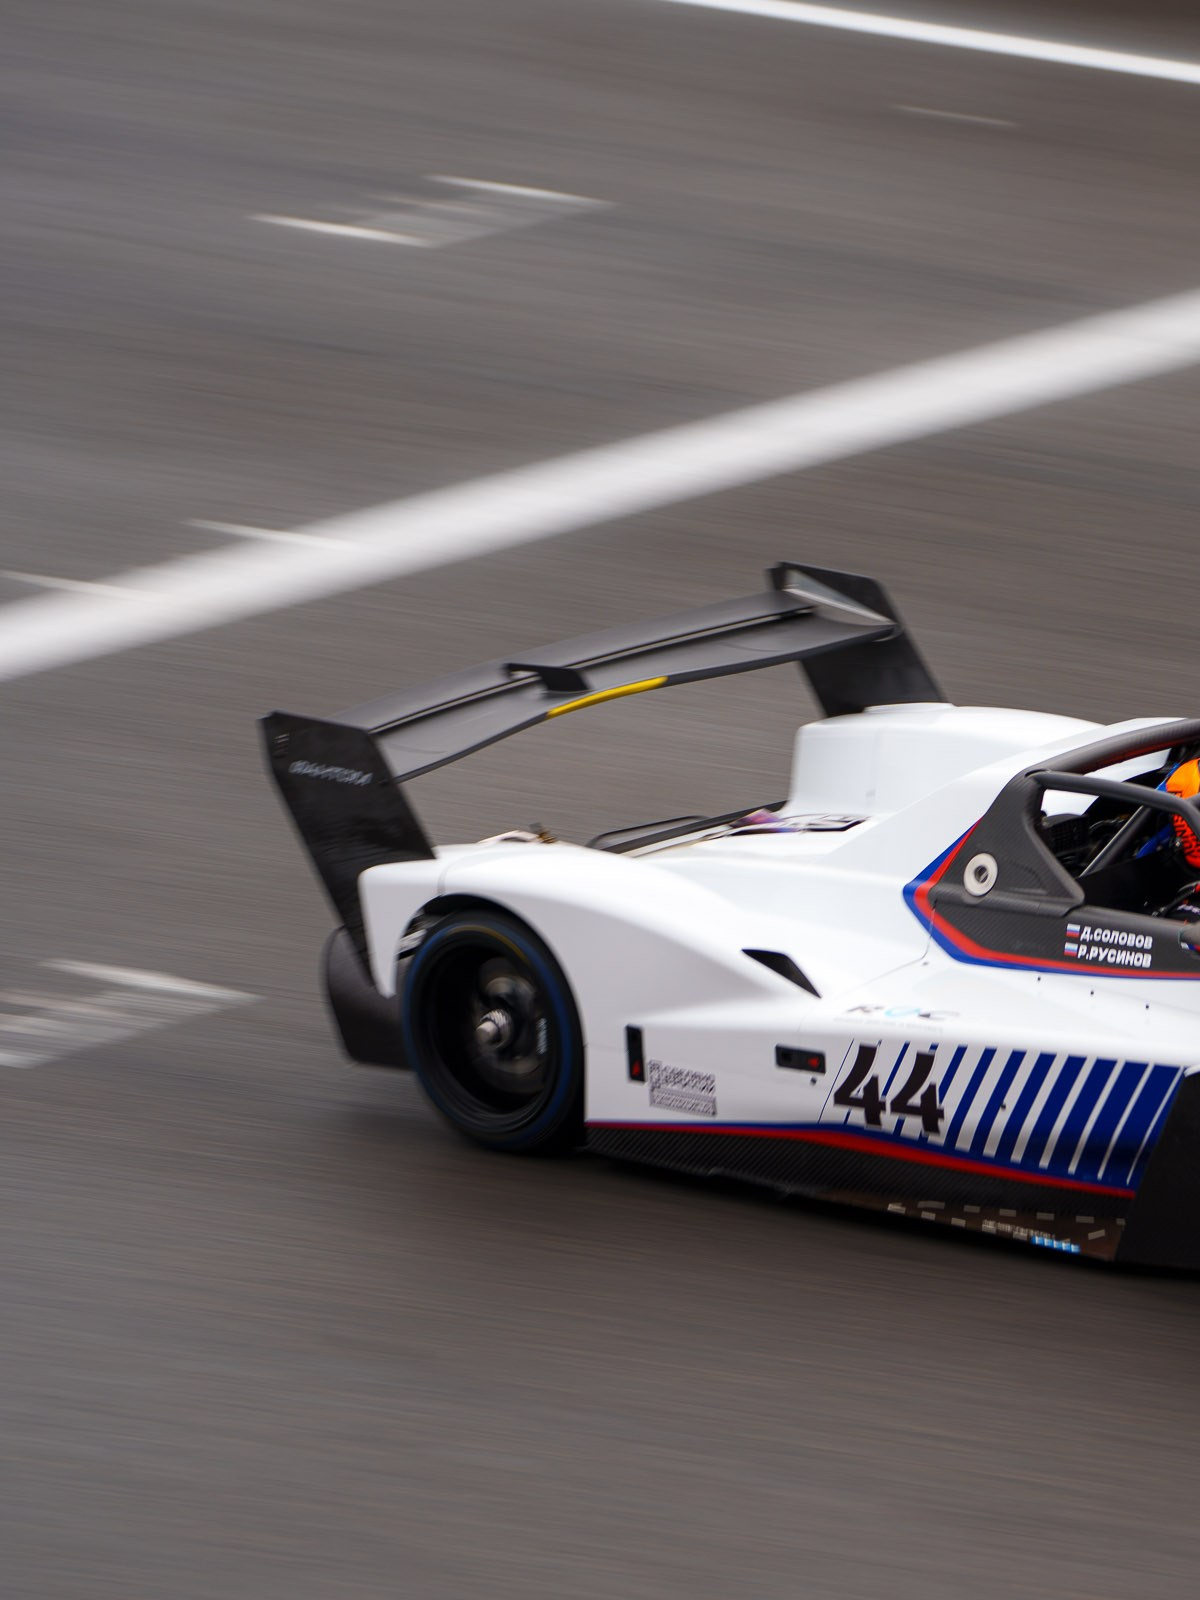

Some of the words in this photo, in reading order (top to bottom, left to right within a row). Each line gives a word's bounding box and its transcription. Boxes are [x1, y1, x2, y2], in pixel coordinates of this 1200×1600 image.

[1079, 925, 1153, 950] Д.СОЛОВОВ
[1077, 943, 1152, 968] Р.РУСИНОВ
[833, 1042, 945, 1134] 44
